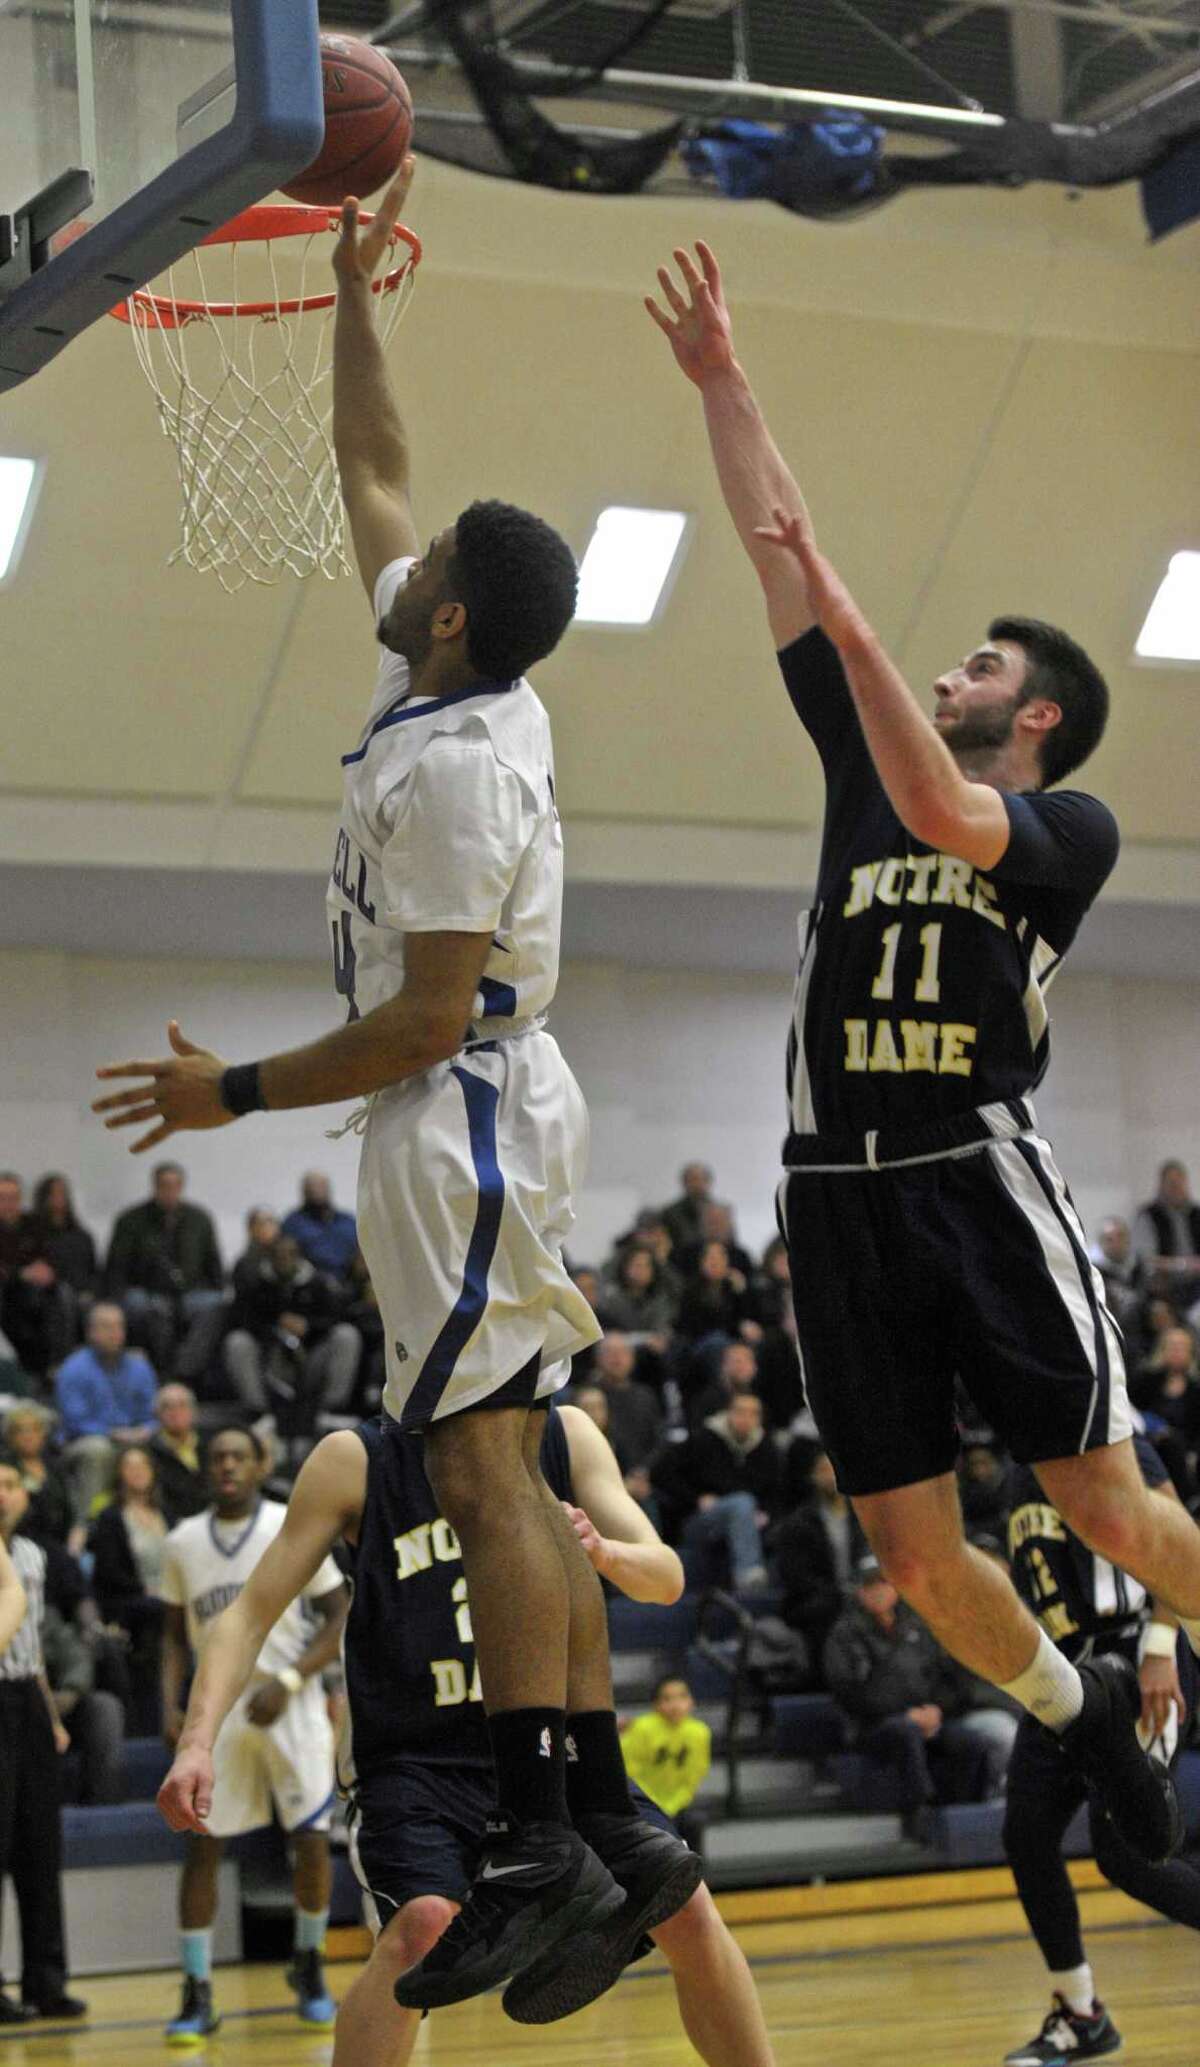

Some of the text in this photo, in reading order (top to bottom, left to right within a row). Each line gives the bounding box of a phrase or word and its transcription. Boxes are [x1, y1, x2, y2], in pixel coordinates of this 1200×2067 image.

[843, 852, 1007, 931] NOTRE
[871, 922, 943, 1004] 11
[843, 1017, 978, 1078] DAME
